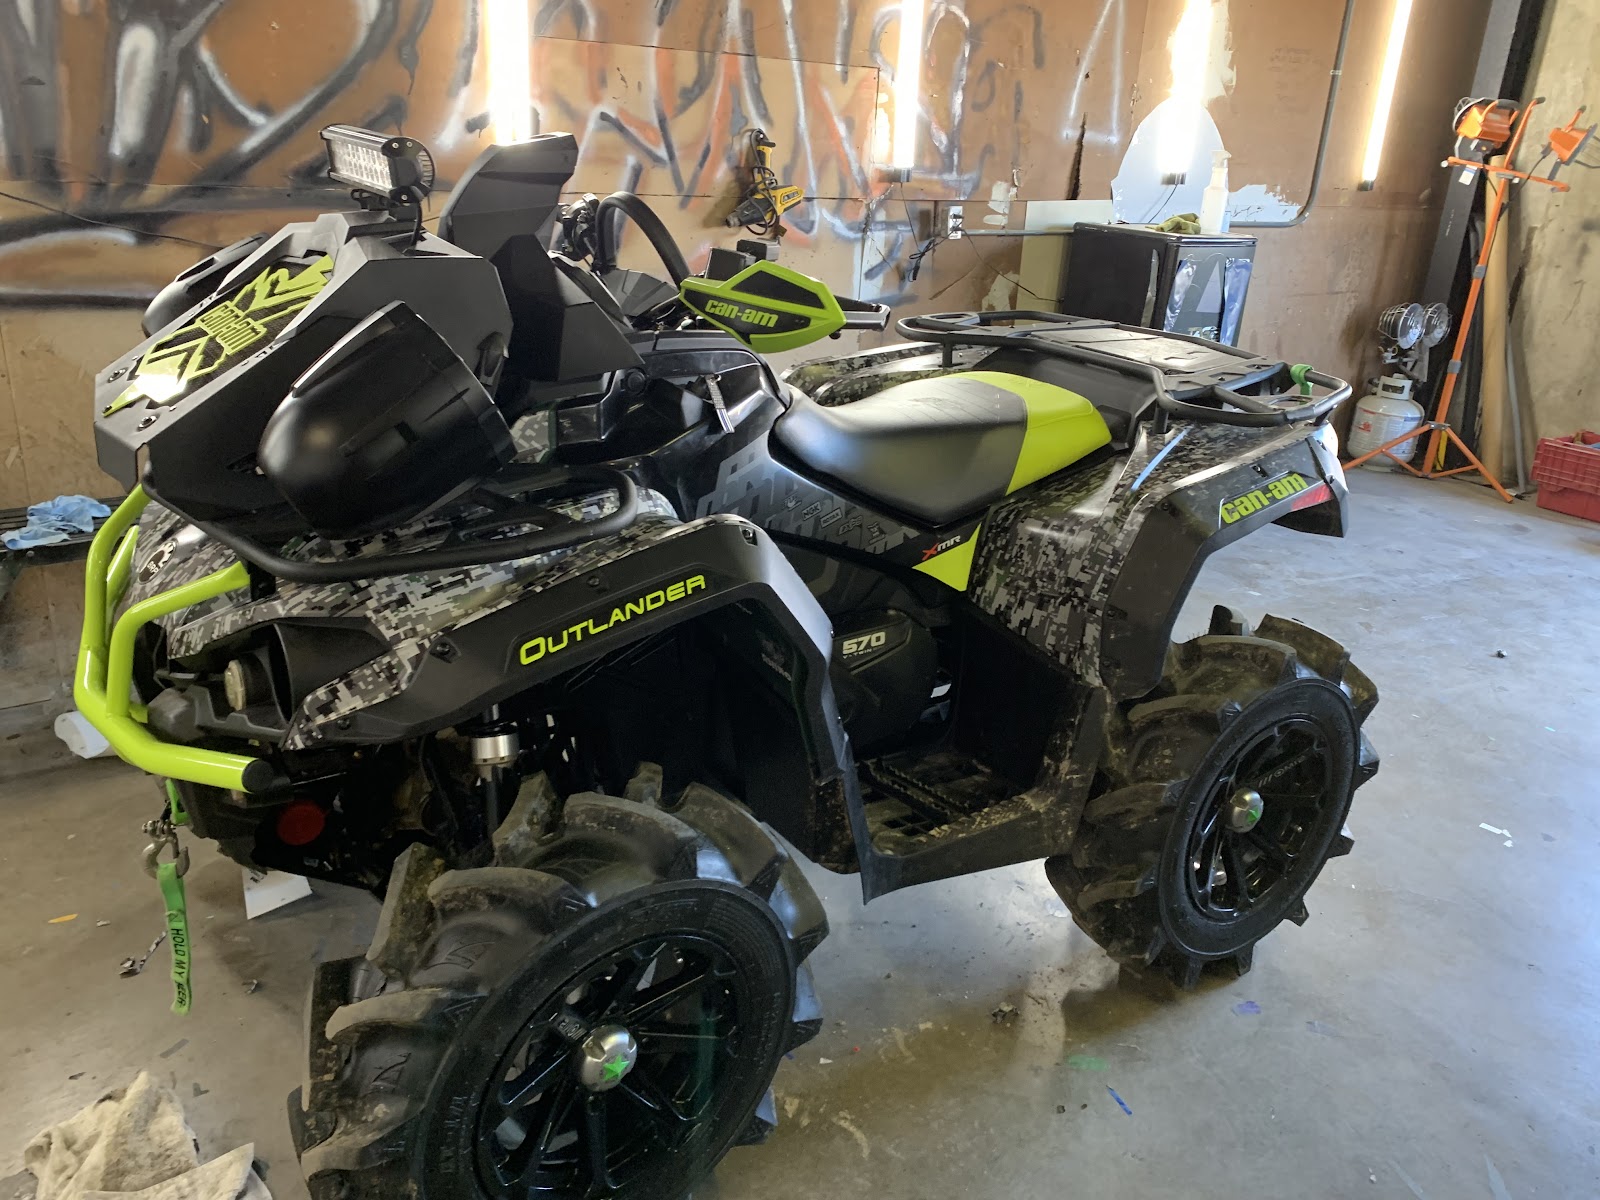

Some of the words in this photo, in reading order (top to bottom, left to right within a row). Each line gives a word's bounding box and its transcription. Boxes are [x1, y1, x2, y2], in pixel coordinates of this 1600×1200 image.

[704, 299, 779, 328] can-am
[802, 502, 820, 519] NGK
[1220, 472, 1309, 525] can-am
[146, 560, 159, 573] BRP
[519, 574, 706, 666] OUTLANDER
[842, 631, 886, 655] 570
[170, 927, 186, 957] HOLD
[173, 959, 186, 979] MY
